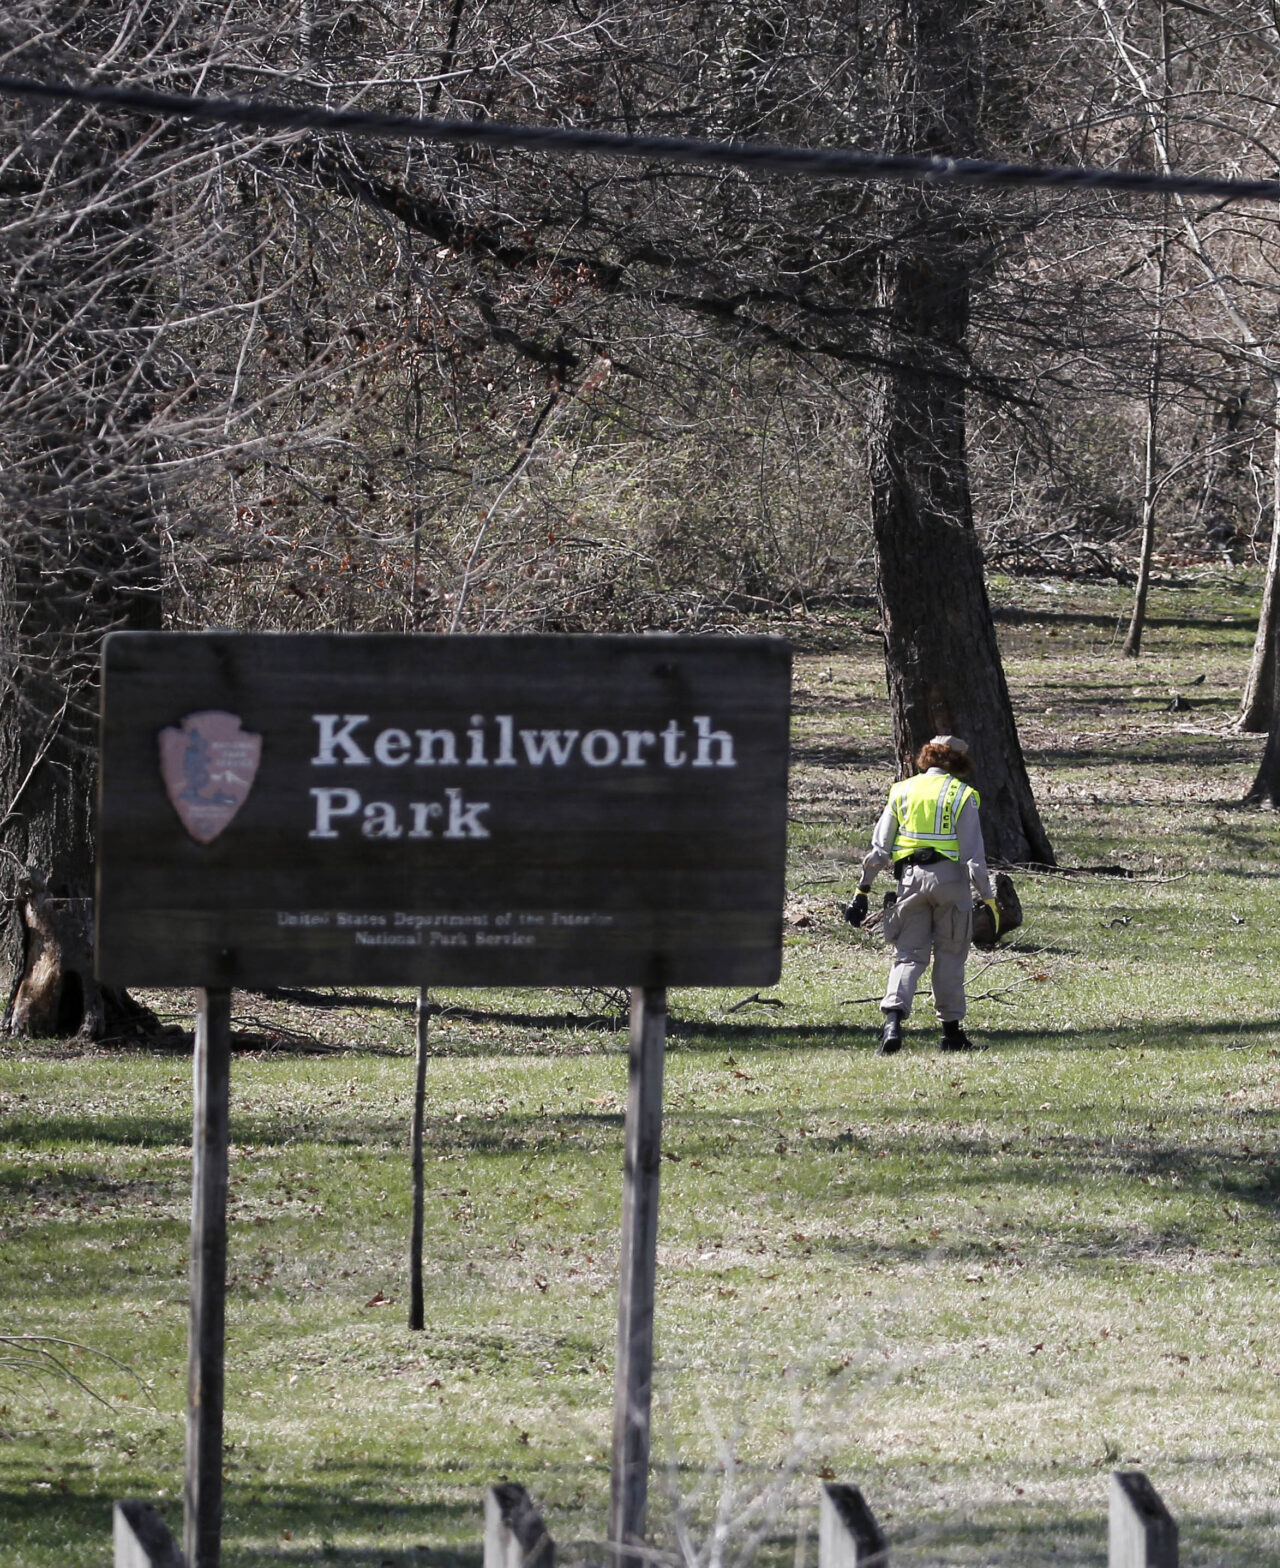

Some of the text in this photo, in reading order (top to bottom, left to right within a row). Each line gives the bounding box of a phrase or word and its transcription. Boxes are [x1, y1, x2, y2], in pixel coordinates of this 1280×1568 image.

[310, 713, 737, 767] Kenilworth
[308, 787, 491, 839] Park
[276, 911, 331, 926] United
[335, 911, 387, 926] States
[393, 911, 489, 929] Department
[495, 911, 513, 926] of
[518, 911, 545, 926] the
[354, 931, 537, 946] National Park Service
